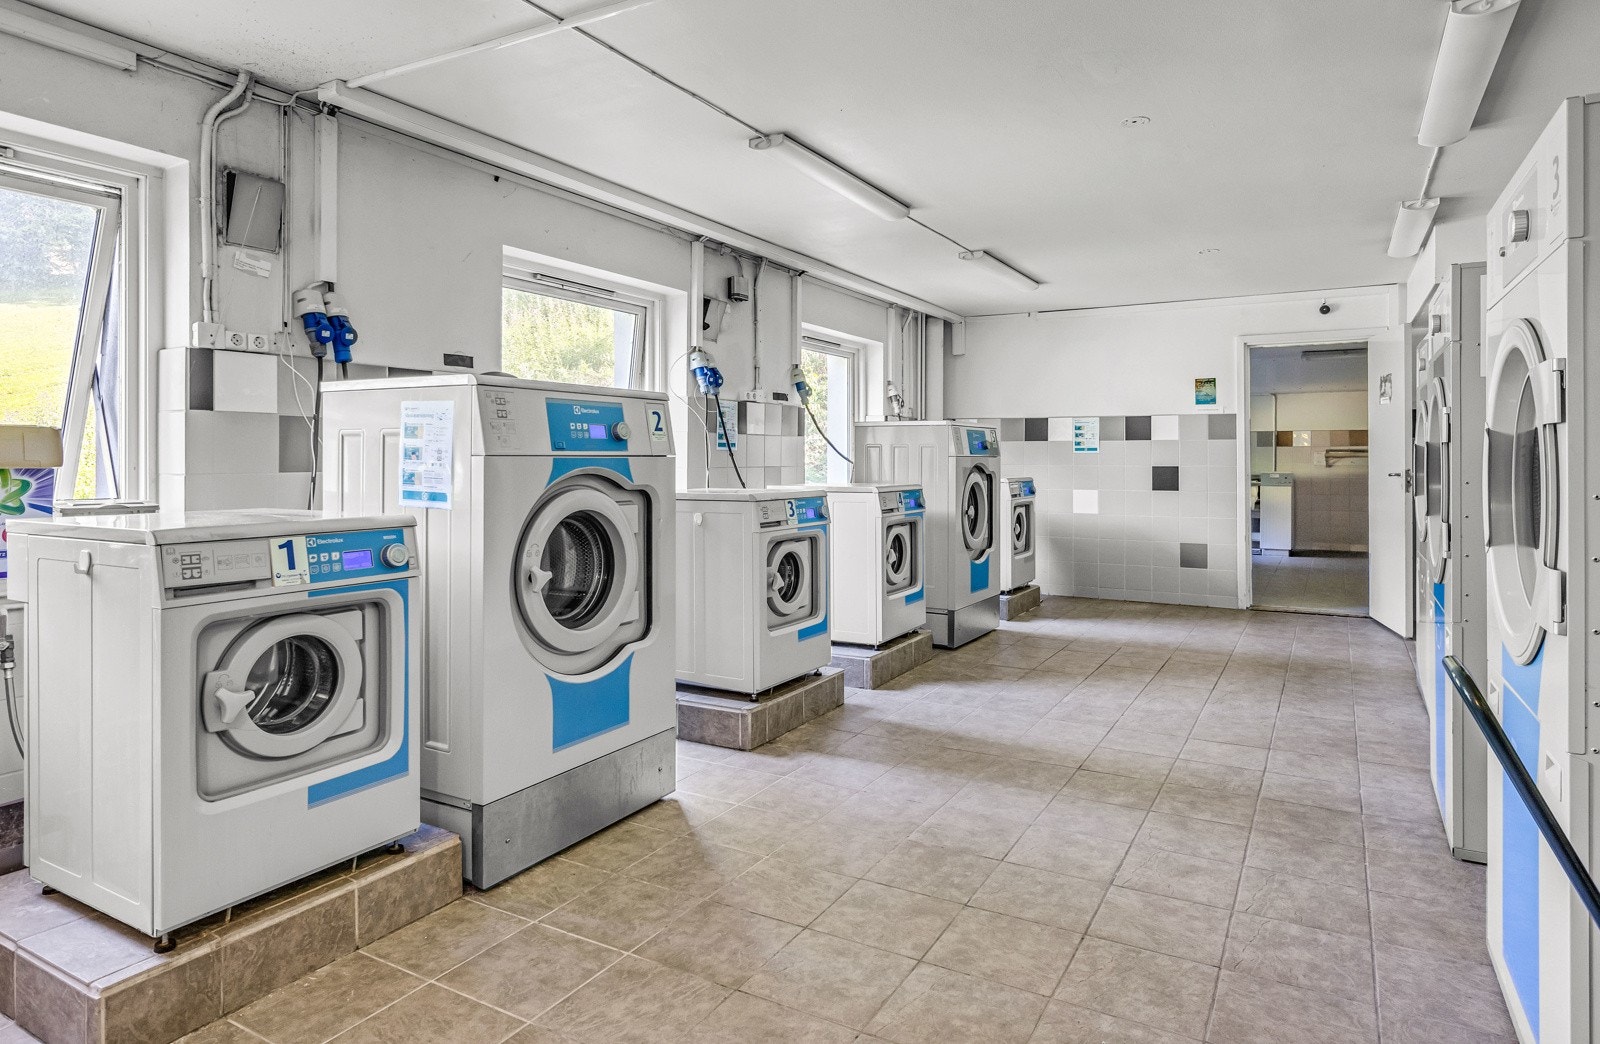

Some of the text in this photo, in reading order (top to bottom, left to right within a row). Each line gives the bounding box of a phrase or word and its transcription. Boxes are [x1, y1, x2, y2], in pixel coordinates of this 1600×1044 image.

[1552, 155, 1560, 200] 3
[652, 410, 664, 431] 2
[787, 500, 795, 518] 3
[278, 539, 296, 570] 1
